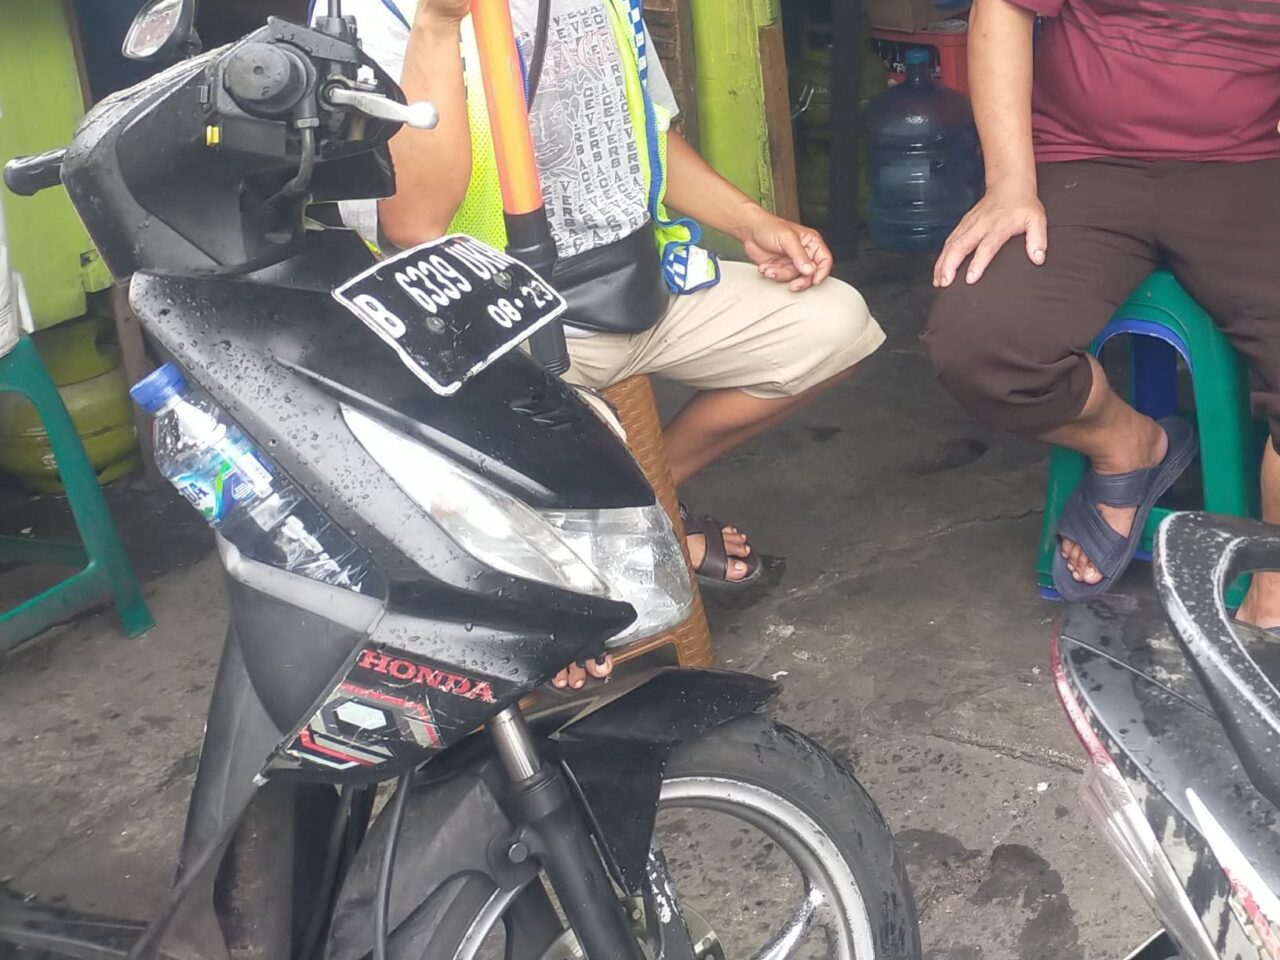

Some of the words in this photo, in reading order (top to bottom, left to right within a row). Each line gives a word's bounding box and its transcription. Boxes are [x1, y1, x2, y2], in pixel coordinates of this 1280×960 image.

[353, 294, 406, 339] B
[395, 254, 473, 313] 6339
[357, 649, 498, 704] HONDA
